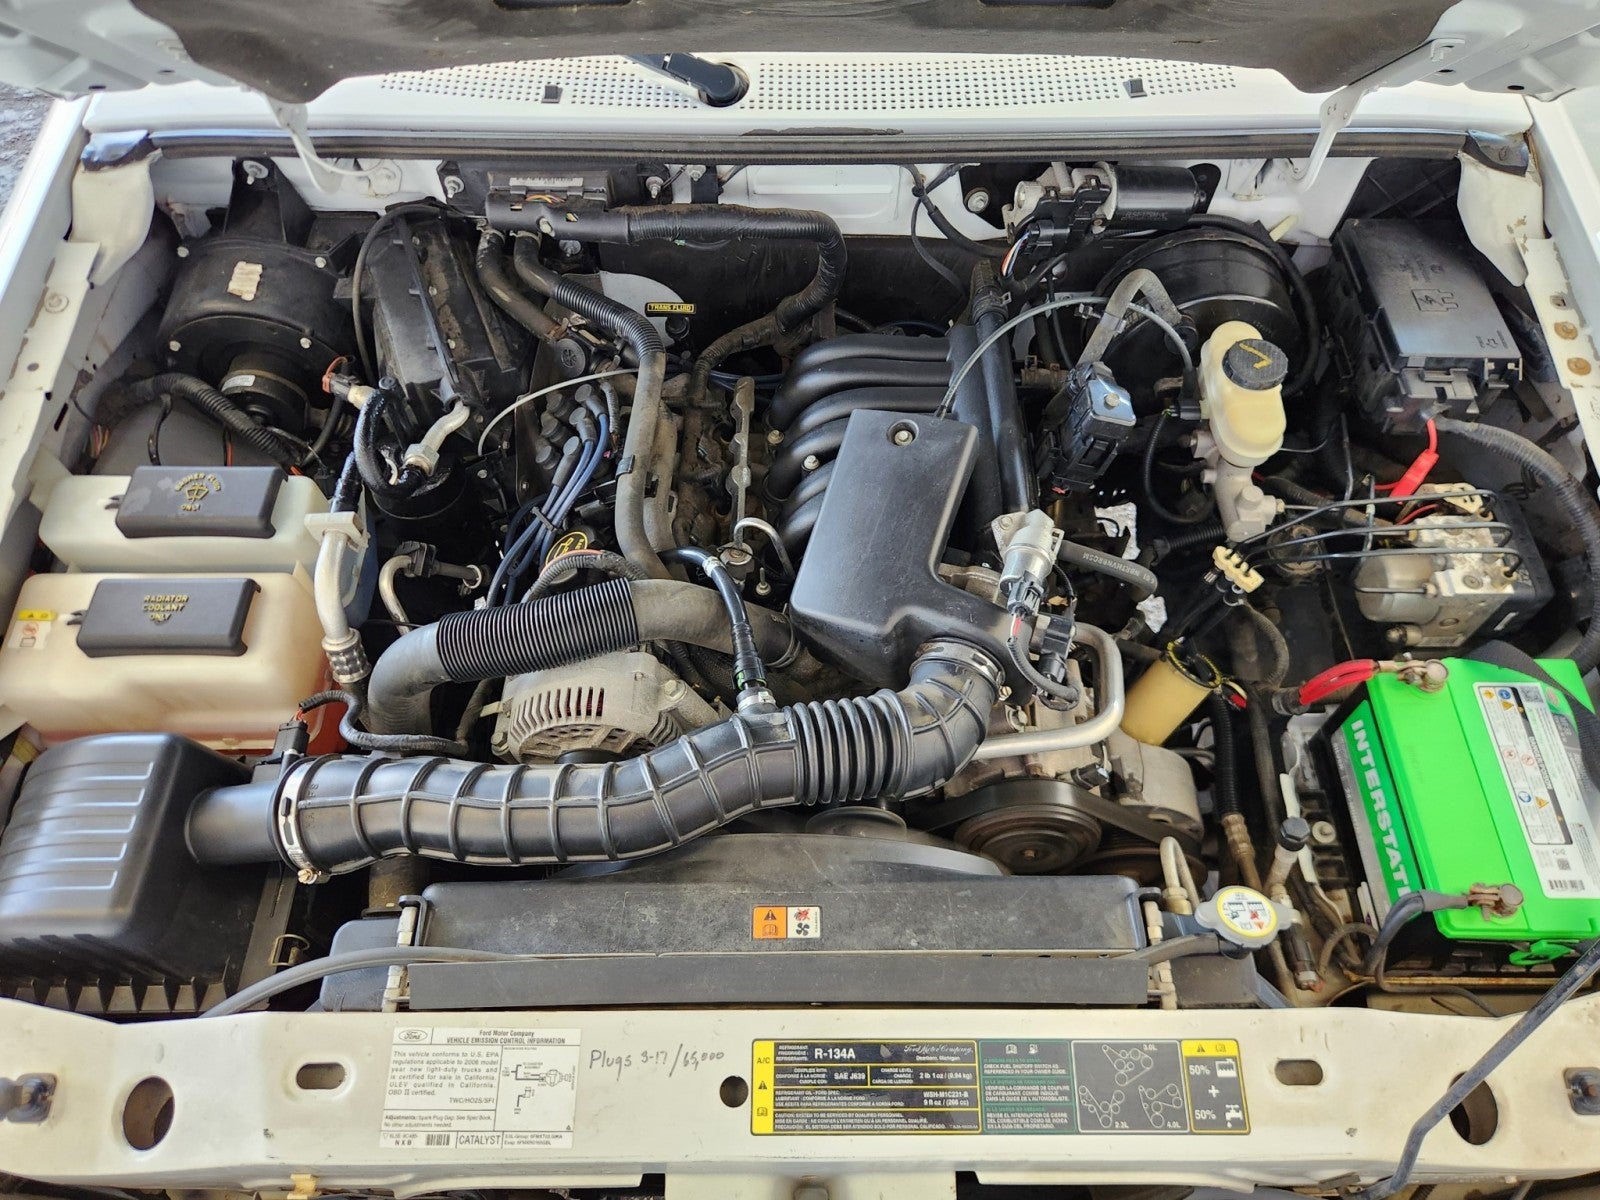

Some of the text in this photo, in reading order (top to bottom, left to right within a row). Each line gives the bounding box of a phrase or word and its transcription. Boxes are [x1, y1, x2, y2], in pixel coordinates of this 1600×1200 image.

[143, 594, 190, 604] RADIATOR
[142, 604, 186, 612] COOLANT
[149, 613, 172, 621] ONLY
[403, 1031, 422, 1040] Ford
[510, 1030, 535, 1038] Company
[1143, 1043, 1158, 1051] 3.0L
[814, 1048, 856, 1060] R-134A
[589, 1049, 632, 1081] Plugs
[1188, 1064, 1211, 1076] 50%
[834, 1072, 866, 1080] SAE J639
[1194, 1109, 1217, 1121] 50%
[1114, 1121, 1130, 1129] 2.3L
[1166, 1121, 1182, 1129] 4.0L
[458, 1135, 502, 1145] CATALYST
